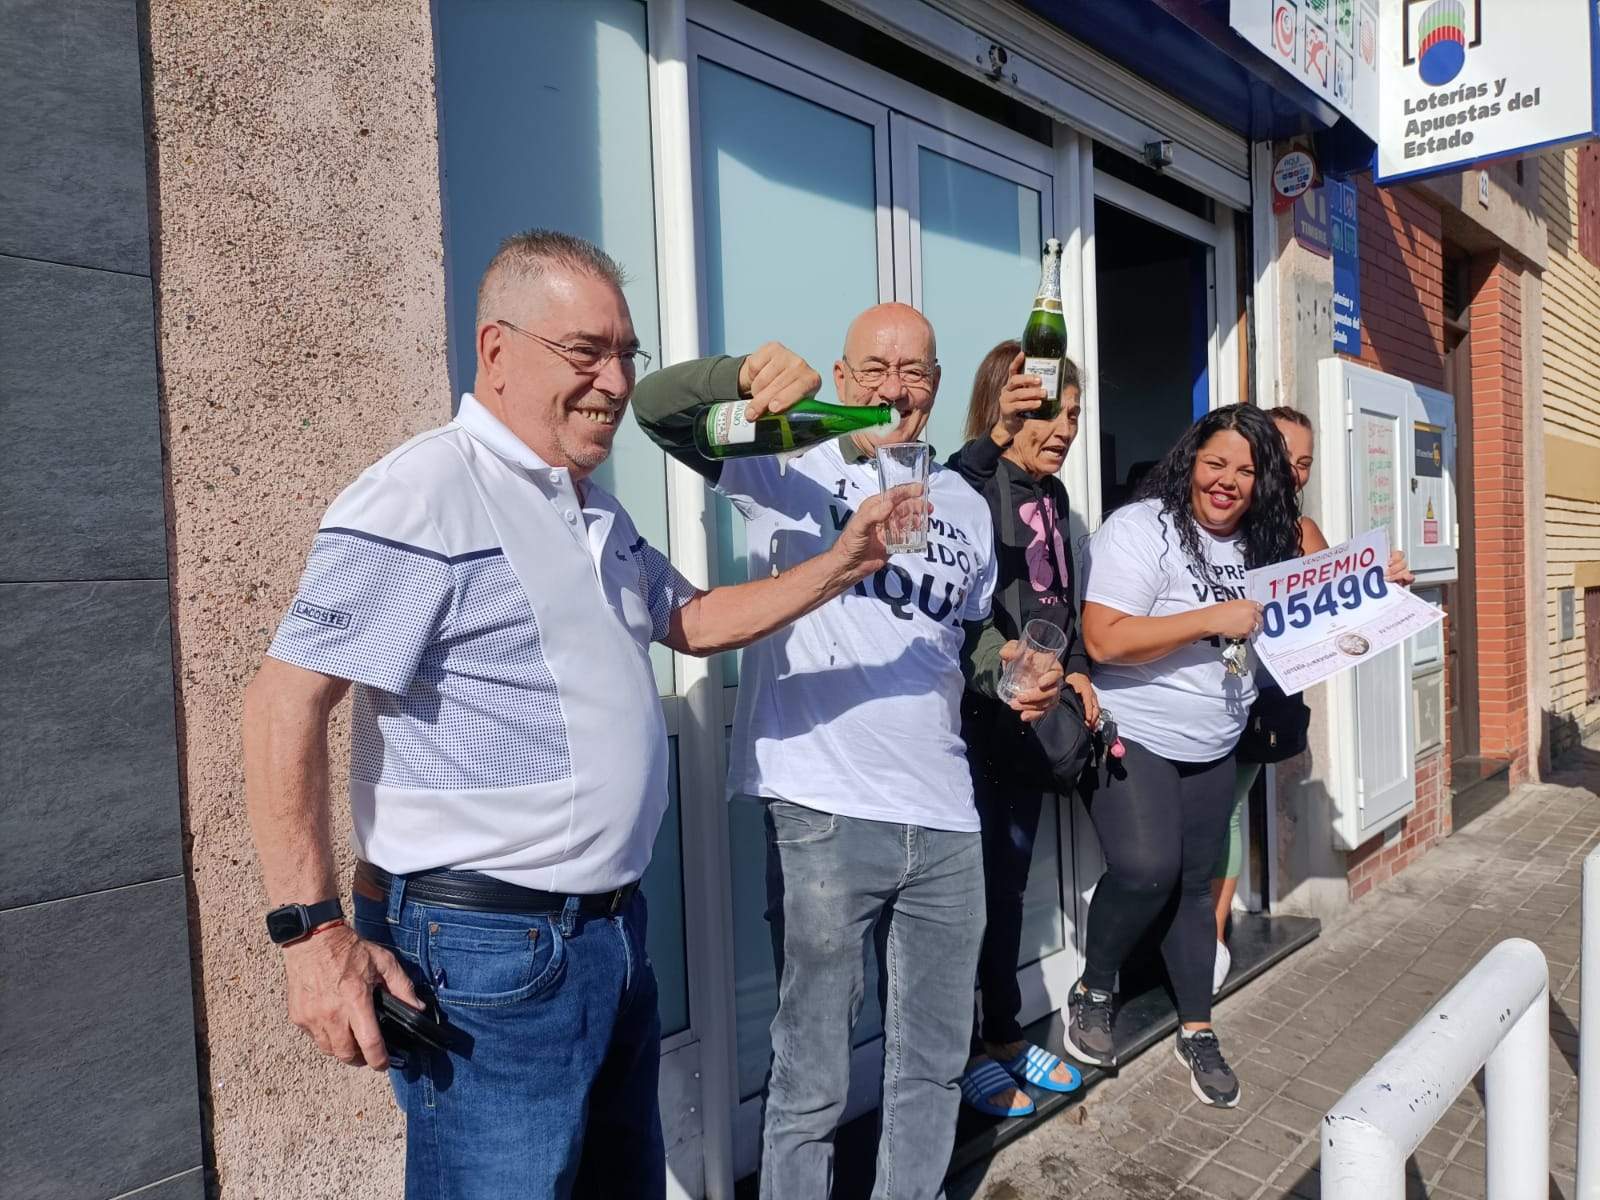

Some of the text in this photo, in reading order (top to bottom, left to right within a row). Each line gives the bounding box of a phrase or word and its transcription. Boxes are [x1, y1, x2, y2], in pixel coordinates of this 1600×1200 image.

[1404, 78, 1507, 116] Loterías y
[1404, 87, 1540, 138] Apuestas del
[1404, 129, 1474, 159] Estado
[1301, 220, 1328, 245] TIMBRE
[1333, 292, 1350, 308] oterías
[1333, 312, 1352, 328] puestas
[1211, 564, 1245, 580] PRE
[1286, 547, 1375, 594] PREMIO
[295, 602, 345, 625] LACOSTE
[1262, 565, 1388, 638] 05490
